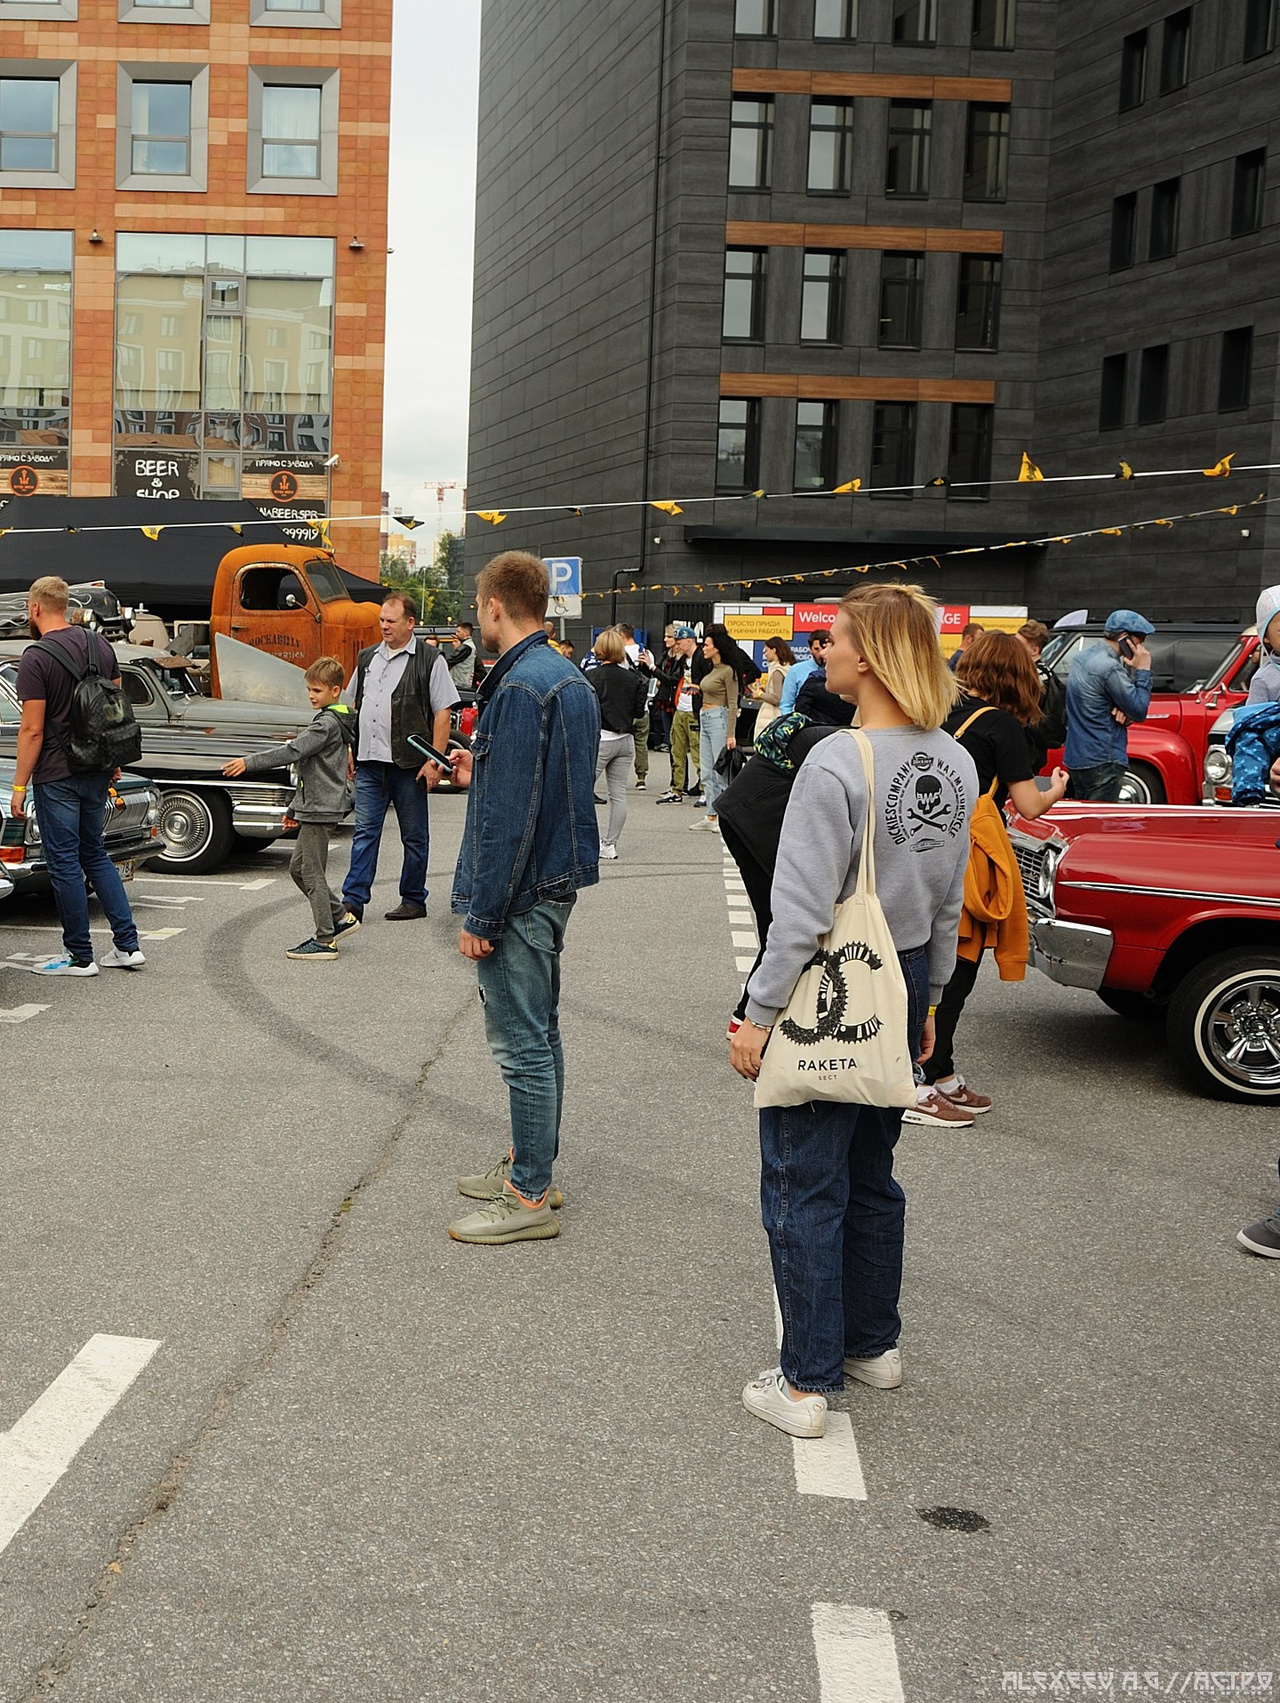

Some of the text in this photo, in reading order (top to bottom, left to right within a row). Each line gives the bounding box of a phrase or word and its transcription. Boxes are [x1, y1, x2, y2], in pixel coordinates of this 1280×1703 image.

[135, 459, 180, 477] BEER
[255, 460, 314, 468] ПРЯМО С ЗАВОДА
[150, 477, 163, 488] &
[551, 562, 573, 595] P
[942, 613, 962, 625] GE
[797, 1058, 858, 1071] RAKETA
